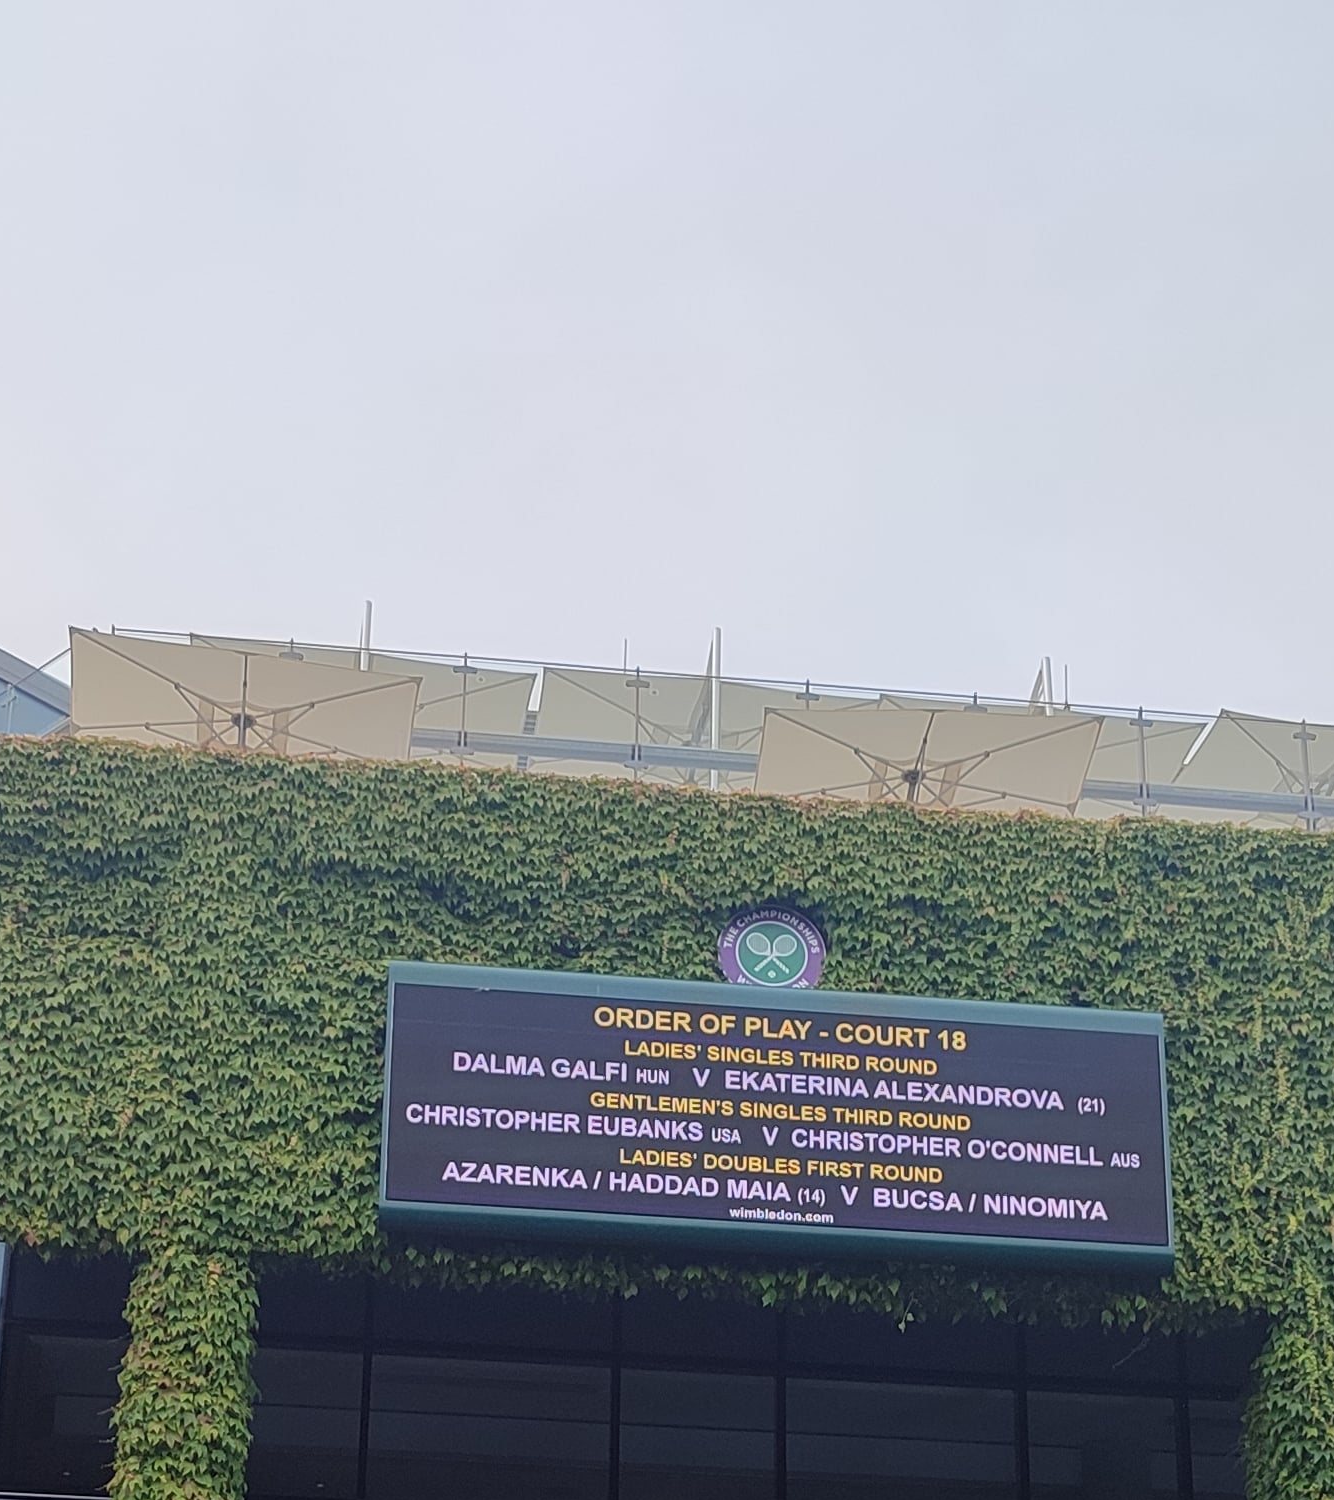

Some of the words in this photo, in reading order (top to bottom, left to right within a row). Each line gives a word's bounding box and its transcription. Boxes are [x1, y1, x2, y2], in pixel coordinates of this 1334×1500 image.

[723, 926, 739, 948] THE
[736, 910, 820, 954] CHAMPIONSHIPS
[594, 1006, 692, 1033] ORDER
[699, 1013, 737, 1036] OF
[745, 1016, 812, 1040] PLAY
[835, 1023, 930, 1049] COURT
[937, 1029, 967, 1051] 18
[624, 1039, 702, 1060] LADIES'
[707, 1045, 794, 1066] SINGLES
[799, 1051, 860, 1071] THIRD
[865, 1055, 938, 1076] ROUND
[453, 1051, 546, 1077] DALMA
[551, 1058, 628, 1083] GALFI
[636, 1068, 670, 1086] HUN
[692, 1067, 711, 1088] V
[724, 1069, 870, 1099] EKATERINA
[873, 1079, 1065, 1111] ALEXANDROVA
[1077, 1096, 1106, 1117] (21)
[590, 1091, 734, 1116] GENTLEMEN'S
[739, 1101, 827, 1122] SINGLES
[832, 1107, 893, 1126] THIRD
[898, 1111, 971, 1131] ROUND
[405, 1103, 581, 1134] CHRISTOPHER
[587, 1114, 704, 1142] EUBANKS
[711, 1127, 742, 1144] USA
[762, 1126, 779, 1147] V
[791, 1128, 962, 1158] CHRISTOPHER
[967, 1139, 1104, 1167] O'CONNELL
[1110, 1152, 1141, 1169] AUS
[619, 1148, 697, 1168] LADIES'
[703, 1153, 801, 1175] DOUBLES
[807, 1160, 865, 1179] FIRST
[869, 1163, 943, 1184] ROUND
[441, 1161, 588, 1190] AZARENKA
[609, 1171, 719, 1198] HADDAD
[726, 1178, 792, 1202] MAIA
[797, 1187, 826, 1207] (14)
[840, 1184, 859, 1206] V
[873, 1187, 964, 1213] BUCSA
[983, 1193, 1109, 1221] NINOMIYA
[728, 1206, 834, 1224] wimbledon.com
